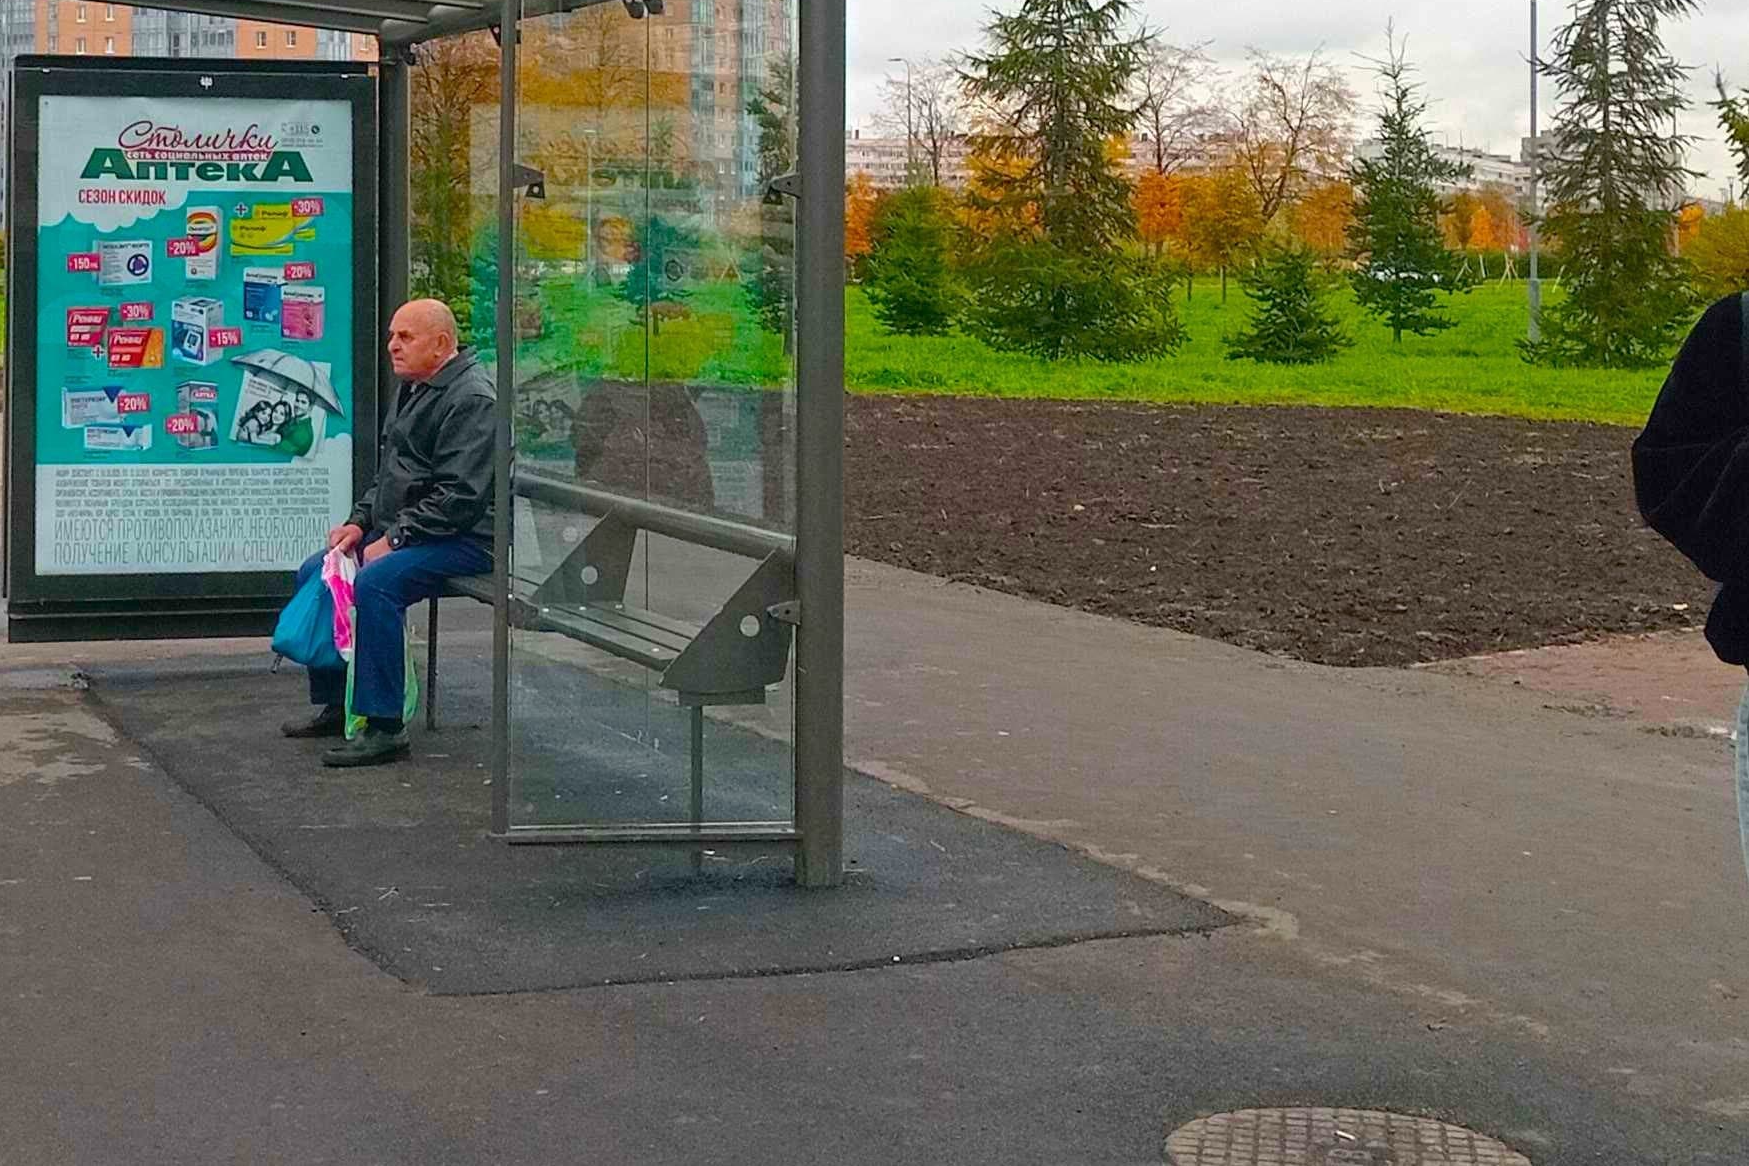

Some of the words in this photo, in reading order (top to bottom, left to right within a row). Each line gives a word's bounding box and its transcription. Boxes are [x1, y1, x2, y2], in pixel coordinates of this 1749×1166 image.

[118, 120, 279, 150] Столички
[78, 189, 116, 204] СЕЗОН
[118, 189, 166, 205] СКИДОК
[293, 200, 321, 214] -30%
[169, 240, 196, 254] -20%
[286, 264, 313, 278] -20%
[122, 305, 149, 318] -30%
[210, 331, 238, 345] -15%
[119, 397, 149, 411] -20%
[167, 418, 195, 432] -20%
[54, 518, 113, 541] ИМЕЮТСЯ
[250, 516, 331, 539] НЕОБХОДИМО
[54, 541, 129, 564] ПОЛУЧЕНИЕ
[137, 540, 235, 563] КОНСУЛЬТАЦИИ
